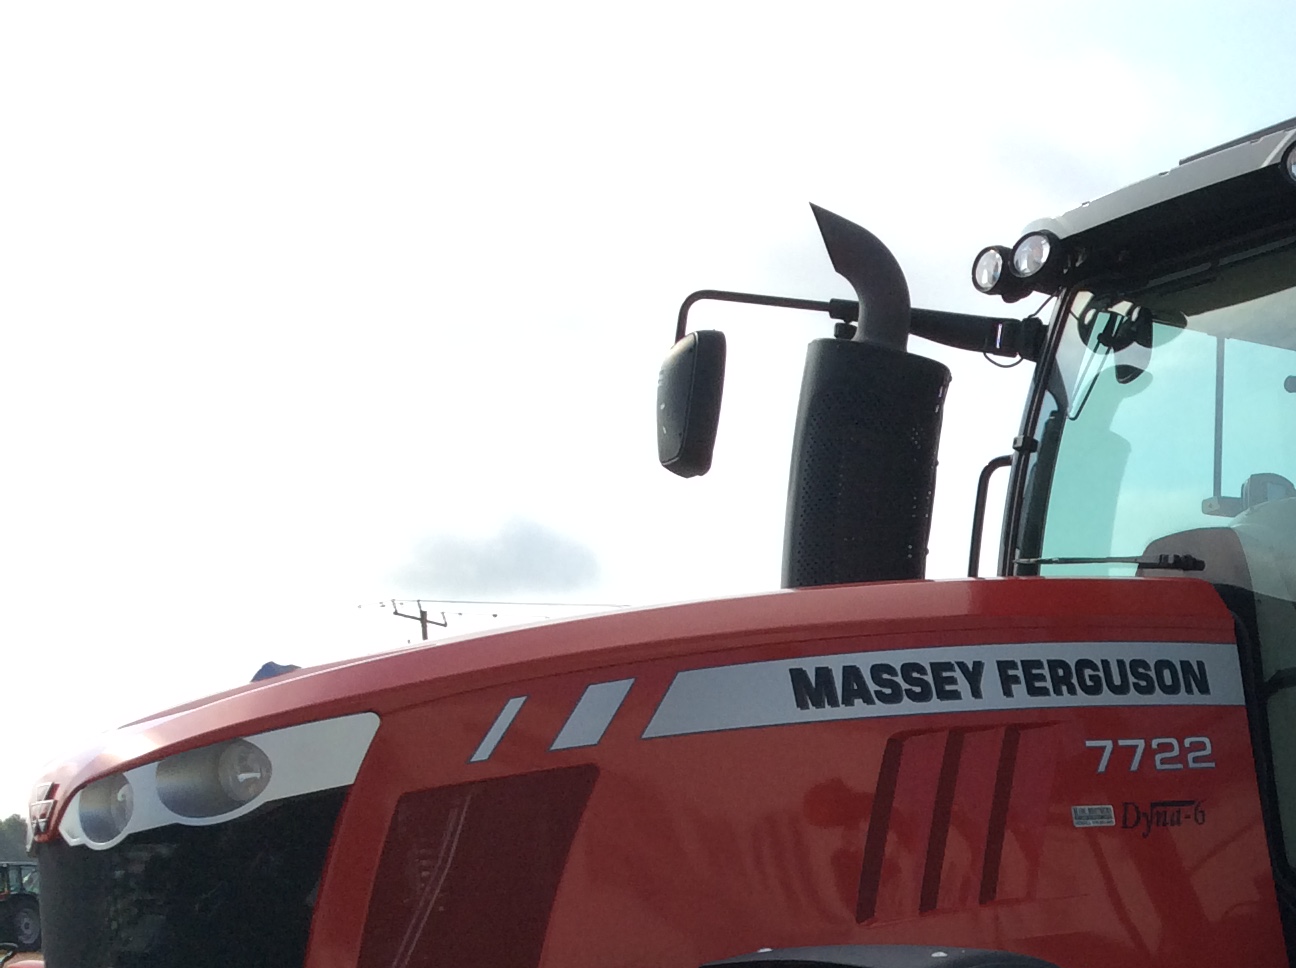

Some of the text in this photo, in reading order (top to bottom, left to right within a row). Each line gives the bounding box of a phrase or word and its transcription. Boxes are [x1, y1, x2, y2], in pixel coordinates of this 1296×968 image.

[789, 658, 1211, 710] MASSEY FERGUSON
[1085, 736, 1216, 773] 7722
[1122, 800, 1206, 838] Dyna-6
